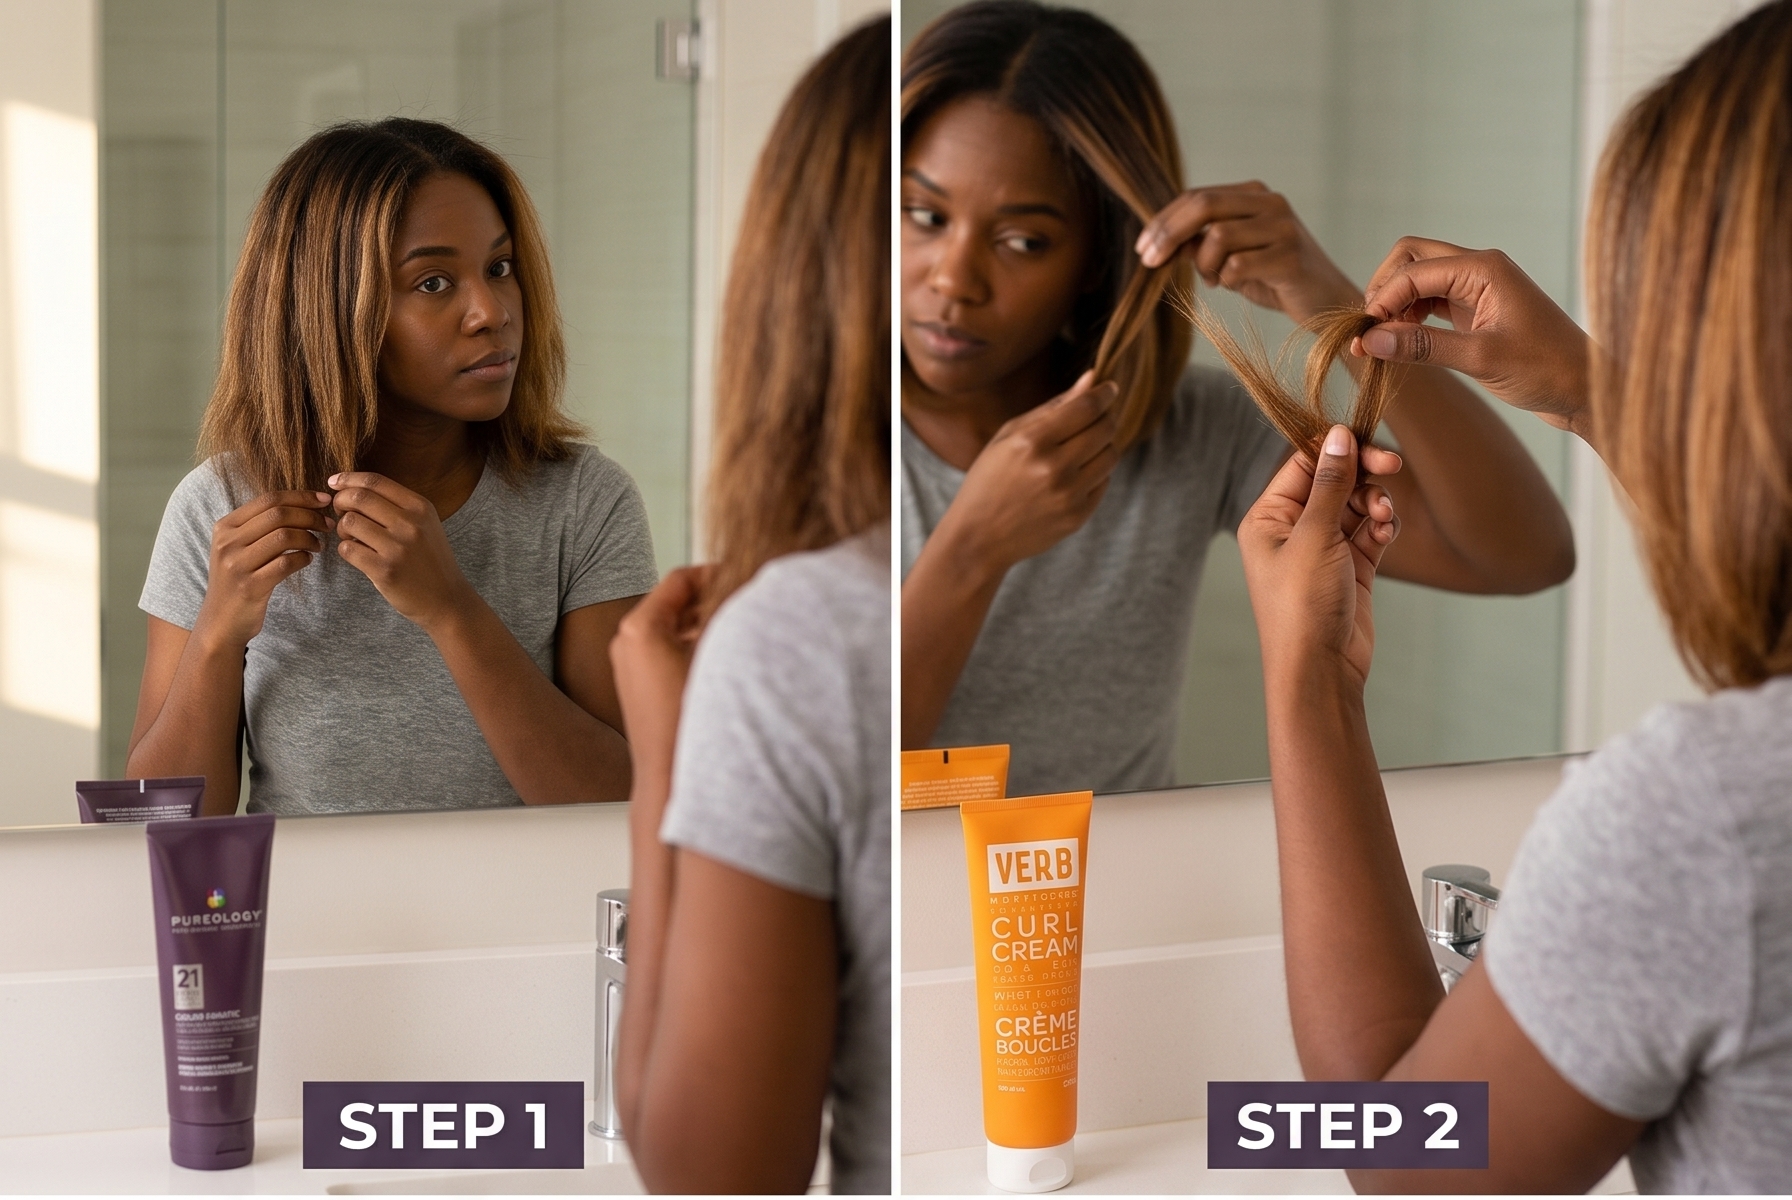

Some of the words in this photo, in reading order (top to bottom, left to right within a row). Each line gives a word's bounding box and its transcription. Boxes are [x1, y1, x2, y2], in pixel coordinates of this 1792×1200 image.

[995, 847, 1073, 885] VERB
[171, 910, 262, 927] PUREOLOGY
[991, 911, 1078, 939] CURL
[991, 935, 1078, 962] CREAM
[177, 969, 199, 988] 21
[995, 1009, 1077, 1037] CRÈME
[996, 1032, 1077, 1055] BOUCLES
